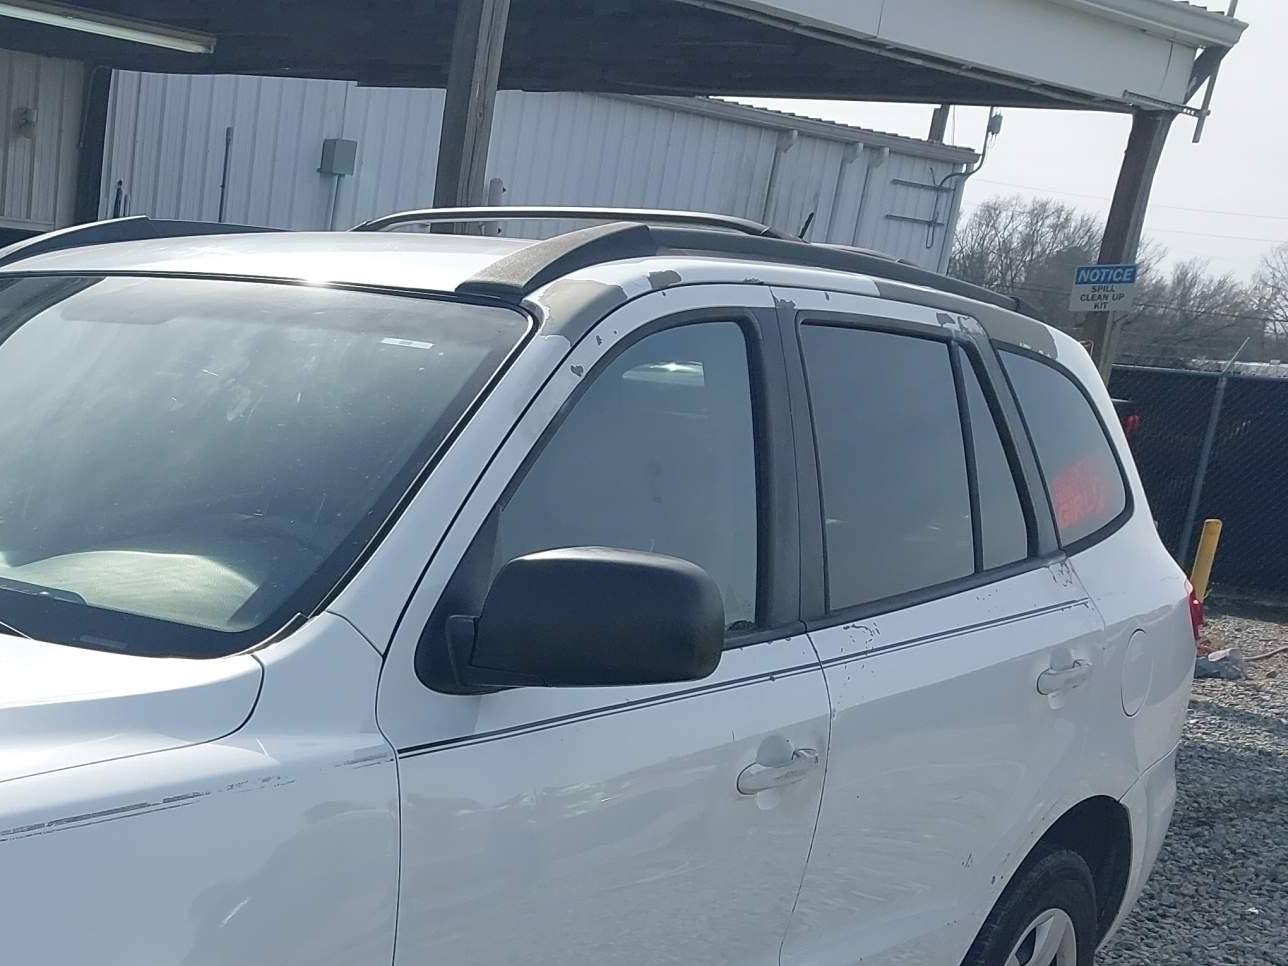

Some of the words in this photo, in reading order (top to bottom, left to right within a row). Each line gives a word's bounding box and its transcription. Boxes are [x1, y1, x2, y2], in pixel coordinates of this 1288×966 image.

[1078, 268, 1133, 282] NOTICE
[1090, 285, 1116, 293] SPILL
[1080, 294, 1109, 302] CLEAN
[1111, 293, 1125, 301] UP
